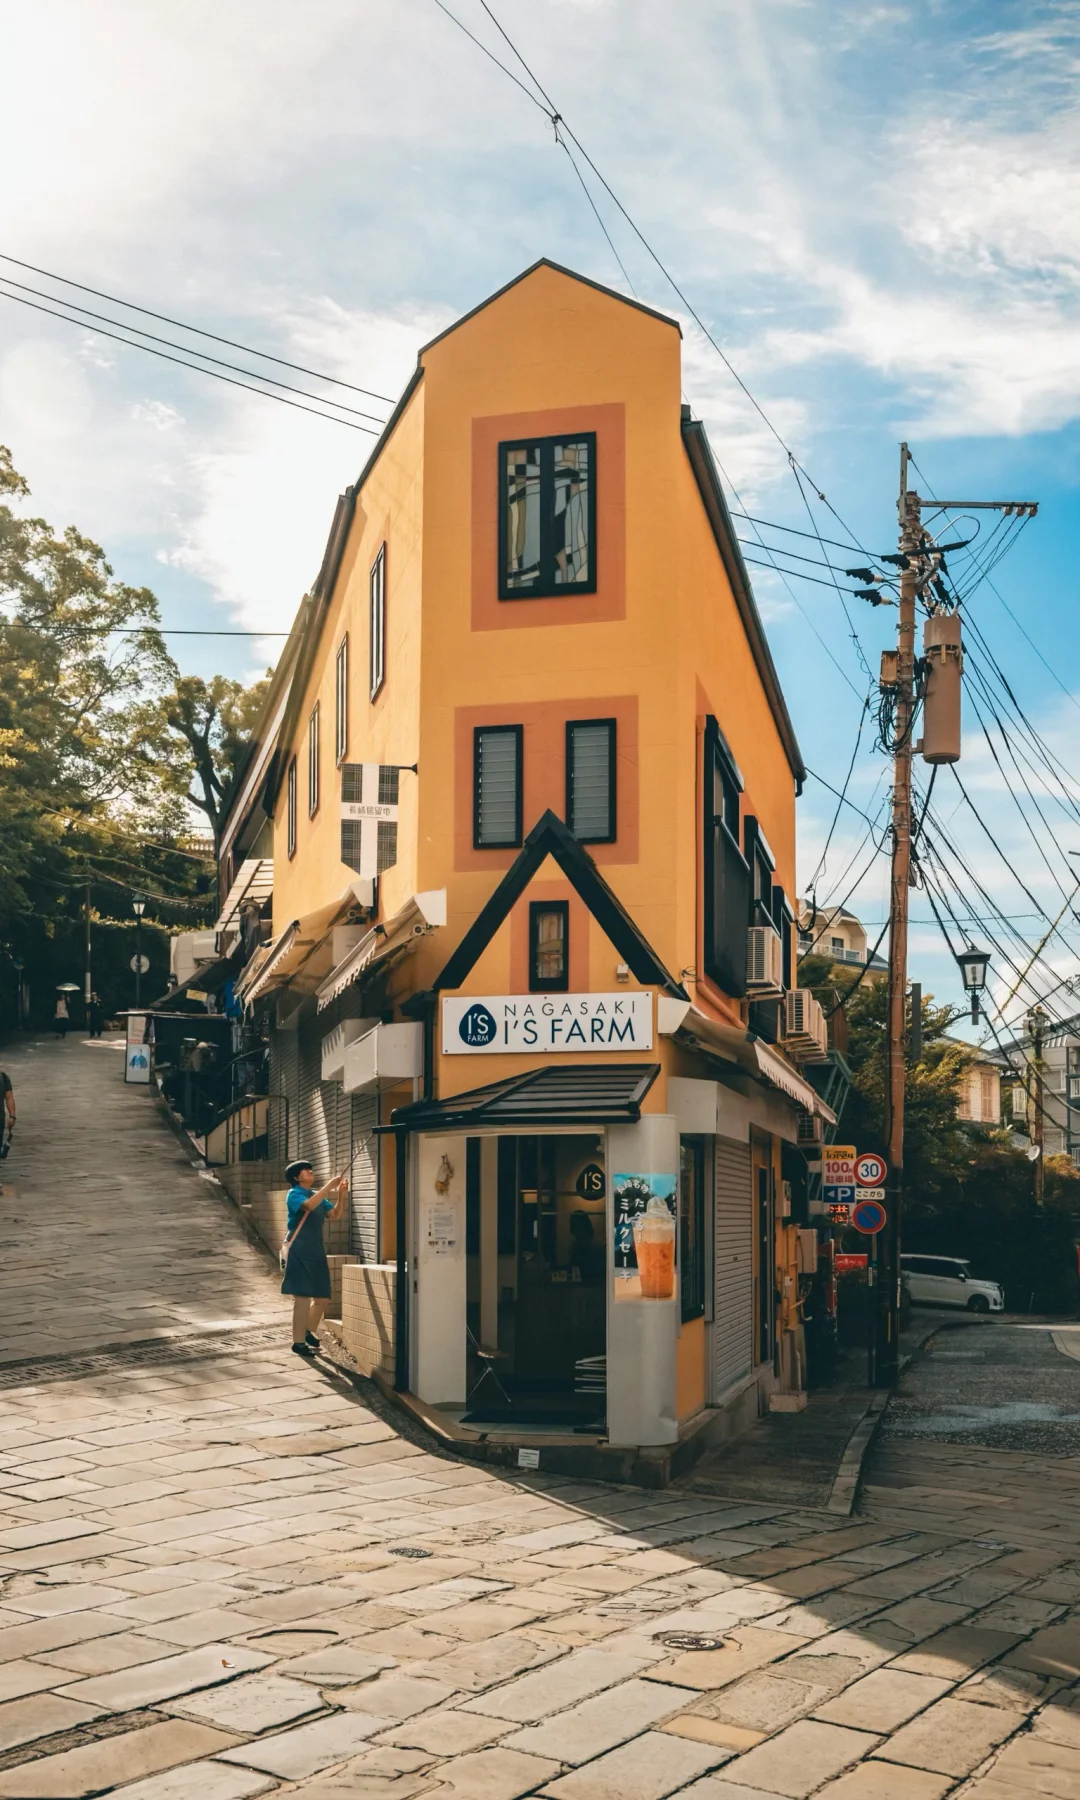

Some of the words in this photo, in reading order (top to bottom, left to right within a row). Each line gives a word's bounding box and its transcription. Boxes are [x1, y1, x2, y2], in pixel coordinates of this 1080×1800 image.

[504, 1000, 635, 1017] NAGASAKI
[467, 1012, 489, 1035] I'S
[504, 1020, 538, 1045] I'S
[551, 1016, 636, 1044] FARM
[467, 1034, 489, 1042] FARM
[860, 1163, 879, 1178] 30
[584, 1171, 602, 1190] I'S
[826, 1175, 854, 1184] 駐車場
[837, 1187, 851, 1202] P
[856, 1190, 883, 1198] ここから
[618, 1198, 631, 1283] ミルクセーキ
